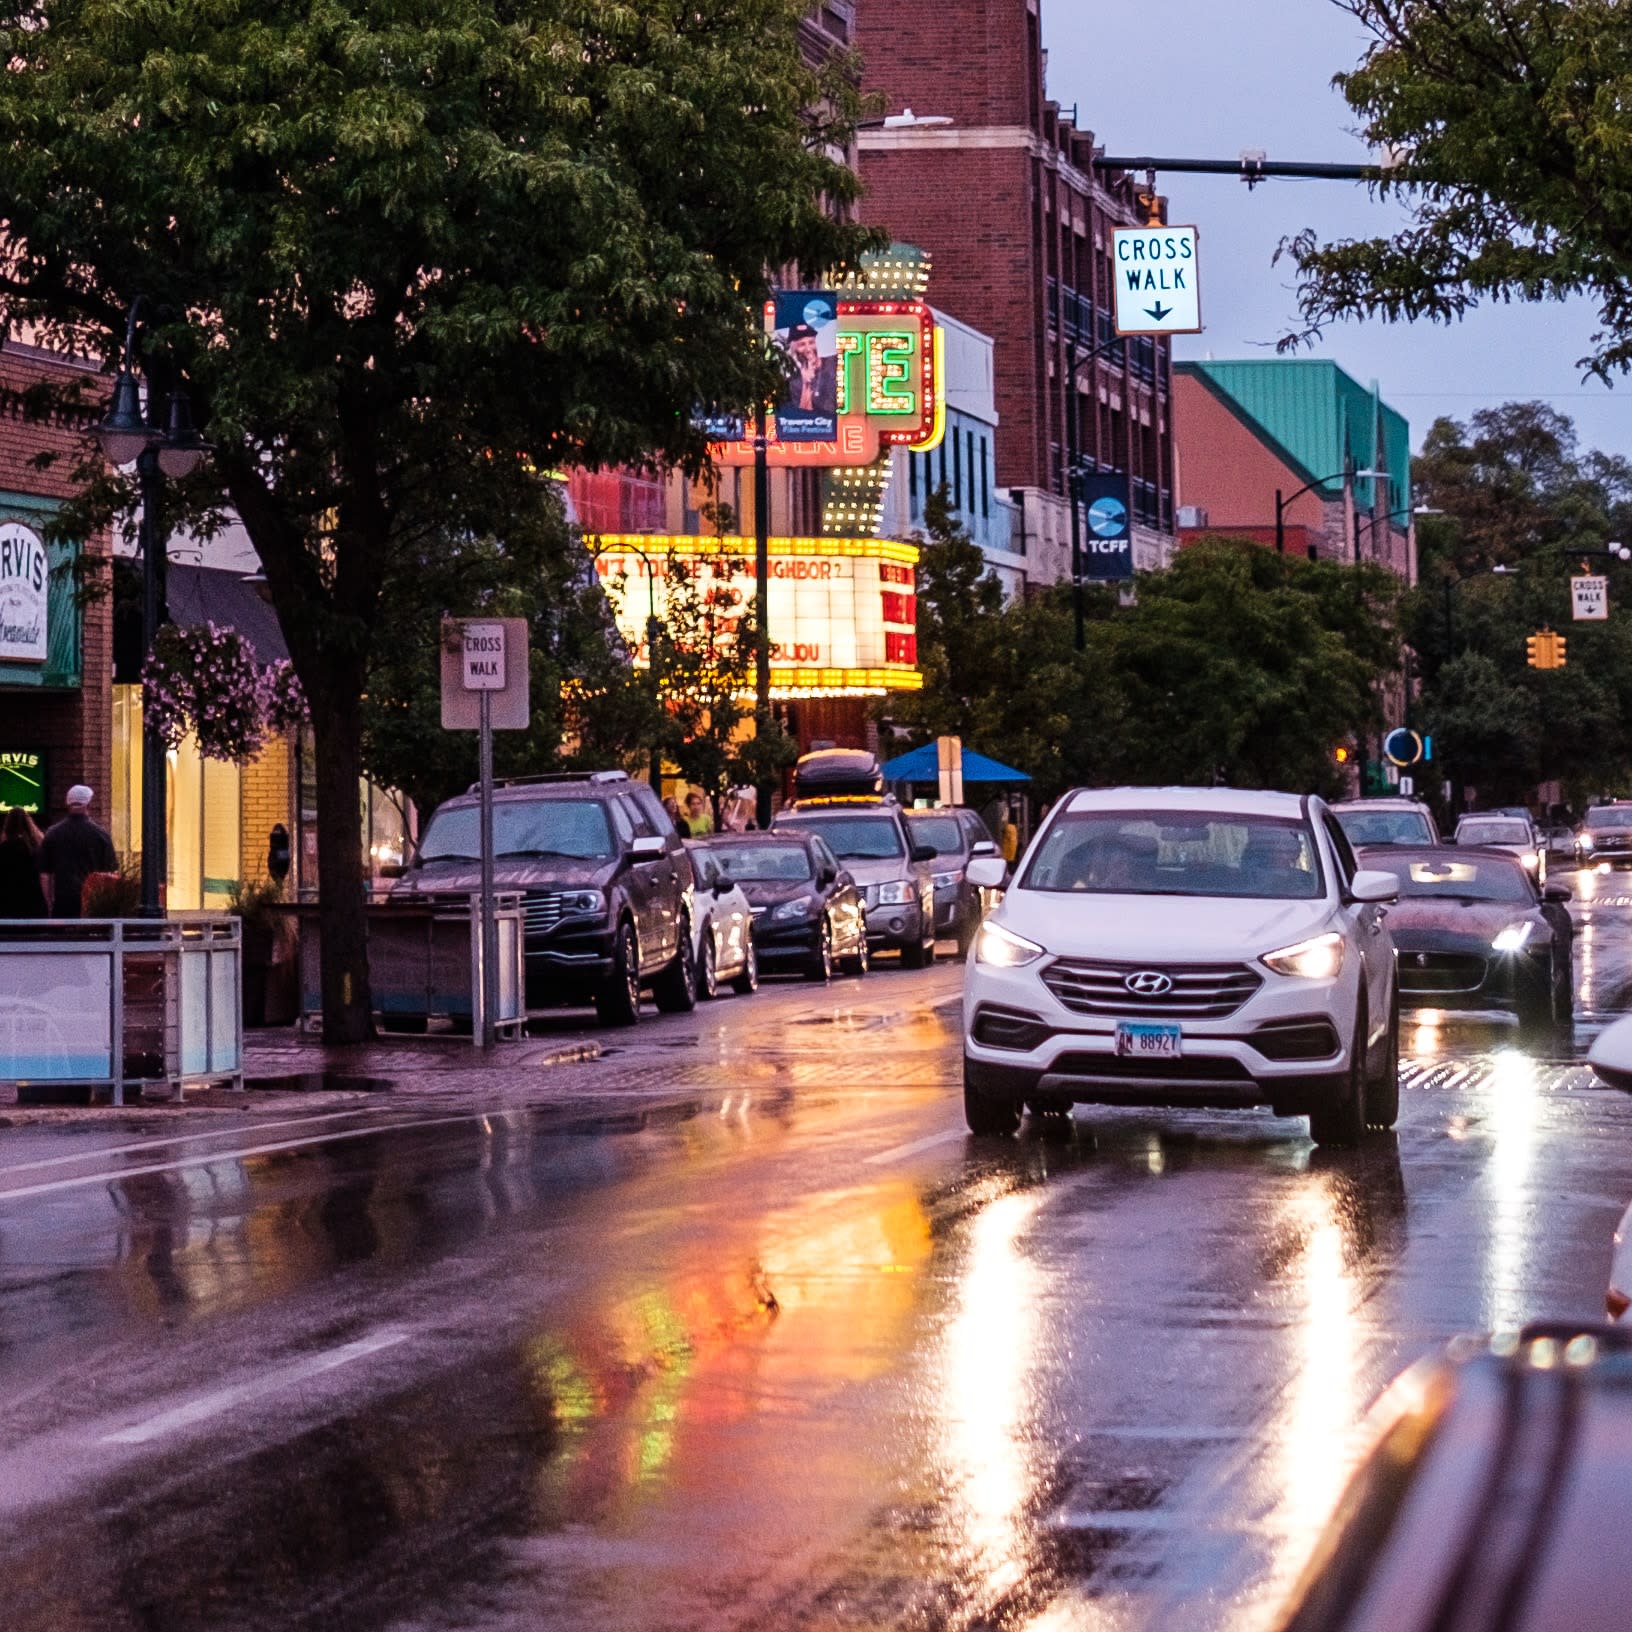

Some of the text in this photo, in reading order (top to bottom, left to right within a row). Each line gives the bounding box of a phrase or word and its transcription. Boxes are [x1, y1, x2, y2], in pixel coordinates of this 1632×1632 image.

[1118, 237, 1192, 261] CROSS
[1126, 268, 1186, 291] WALK
[815, 416, 833, 428] City
[1088, 539, 1129, 553] TCFF
[466, 637, 502, 652] CROSS
[470, 661, 498, 676] WALK
[1140, 1032, 1177, 1051] 88927
